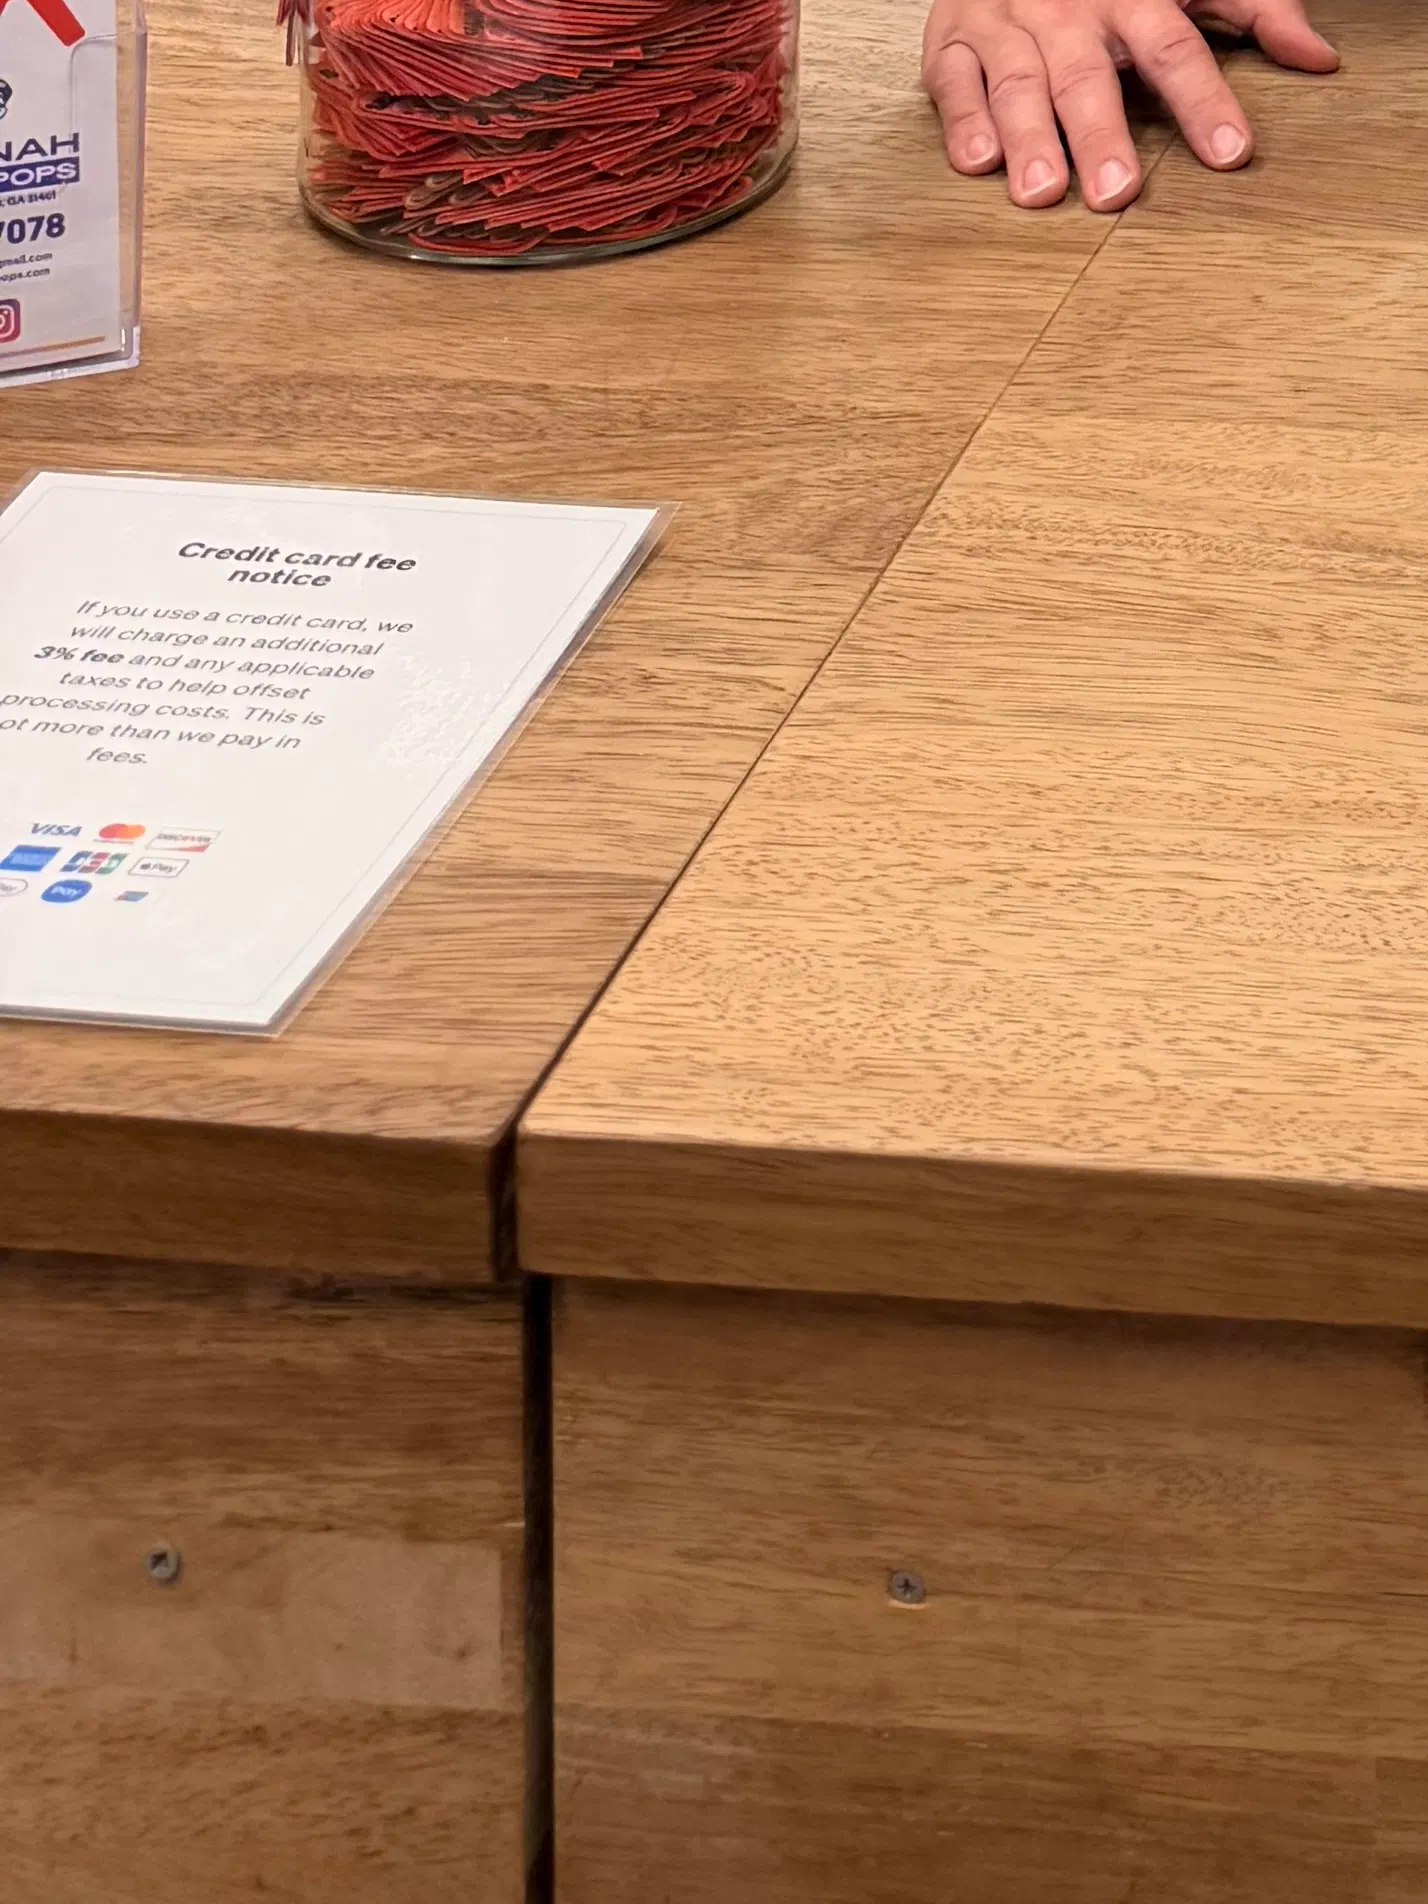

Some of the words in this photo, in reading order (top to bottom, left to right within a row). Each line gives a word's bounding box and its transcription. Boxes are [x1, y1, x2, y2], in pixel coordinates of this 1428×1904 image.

[0, 212, 66, 244] 078
[178, 542, 281, 564] Credit
[284, 550, 363, 569] card
[364, 553, 417, 571] fee
[227, 568, 332, 587] notice
[76, 600, 101, 615] If
[95, 605, 149, 619] you
[153, 607, 200, 621] use
[203, 612, 220, 623] a
[225, 611, 302, 628] credit
[305, 615, 369, 633] card,
[377, 621, 414, 635] we
[70, 624, 116, 640] will
[117, 627, 209, 647] charge
[212, 635, 246, 648] an
[250, 637, 385, 656] additional
[33, 645, 80, 662] 3%
[79, 648, 126, 664] fee
[128, 653, 184, 668] and
[183, 657, 236, 675] any
[236, 660, 376, 682] applicable
[59, 671, 133, 690] taxes
[135, 675, 164, 691] to
[167, 678, 228, 697] help
[232, 682, 312, 700] offset
[155, 703, 232, 721] costs.
[244, 705, 299, 725] This
[300, 708, 327, 727] is
[31, 720, 105, 737] more
[109, 723, 172, 742] than
[177, 729, 216, 744] we
[217, 731, 274, 750] pay
[274, 733, 302, 749] in
[86, 746, 149, 766] fees.
[31, 822, 82, 837] VISA
